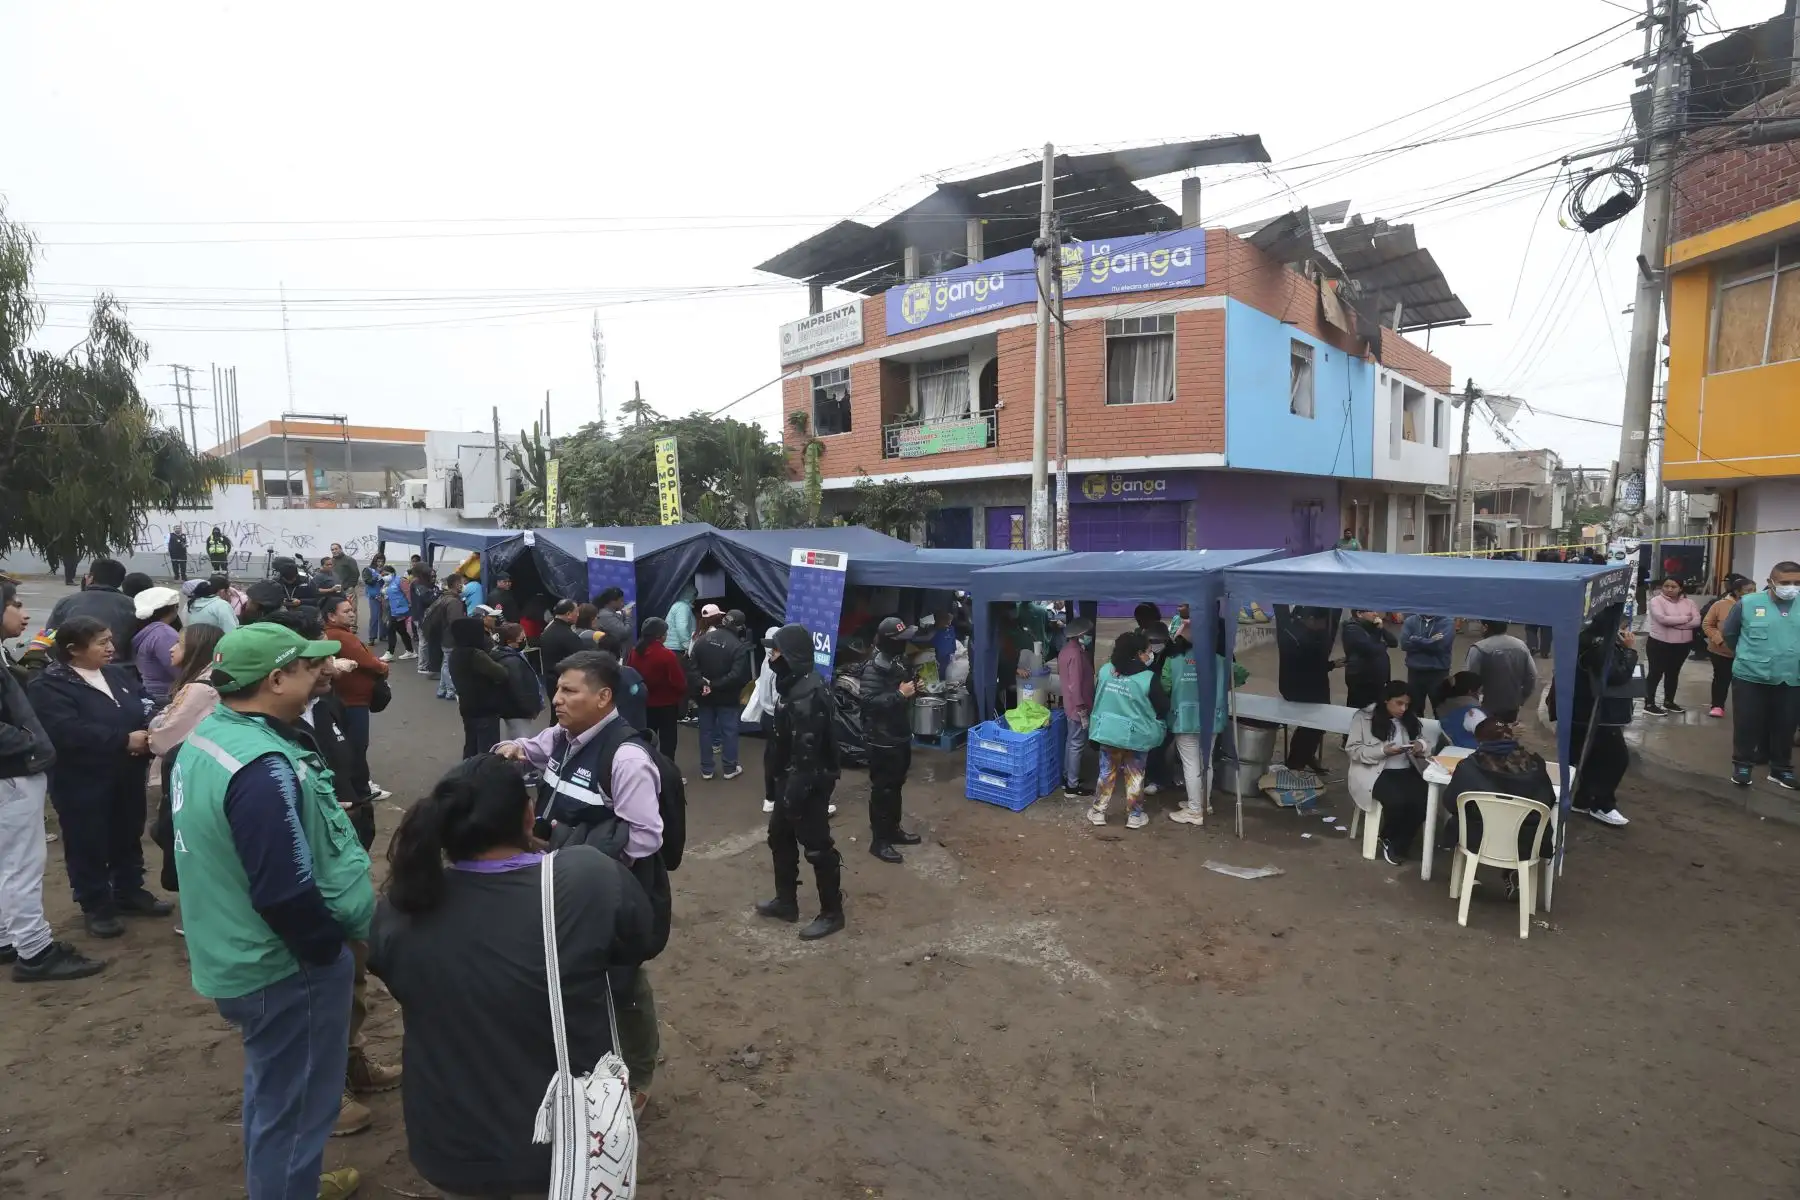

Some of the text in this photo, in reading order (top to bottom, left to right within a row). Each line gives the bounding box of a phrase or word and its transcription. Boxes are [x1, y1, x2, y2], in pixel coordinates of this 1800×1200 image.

[1091, 244, 1110, 256] La
[1090, 246, 1191, 283] ganga
[935, 272, 1004, 312] ganga
[797, 304, 856, 332] IMPRENTA
[1111, 479, 1166, 495] ganga
